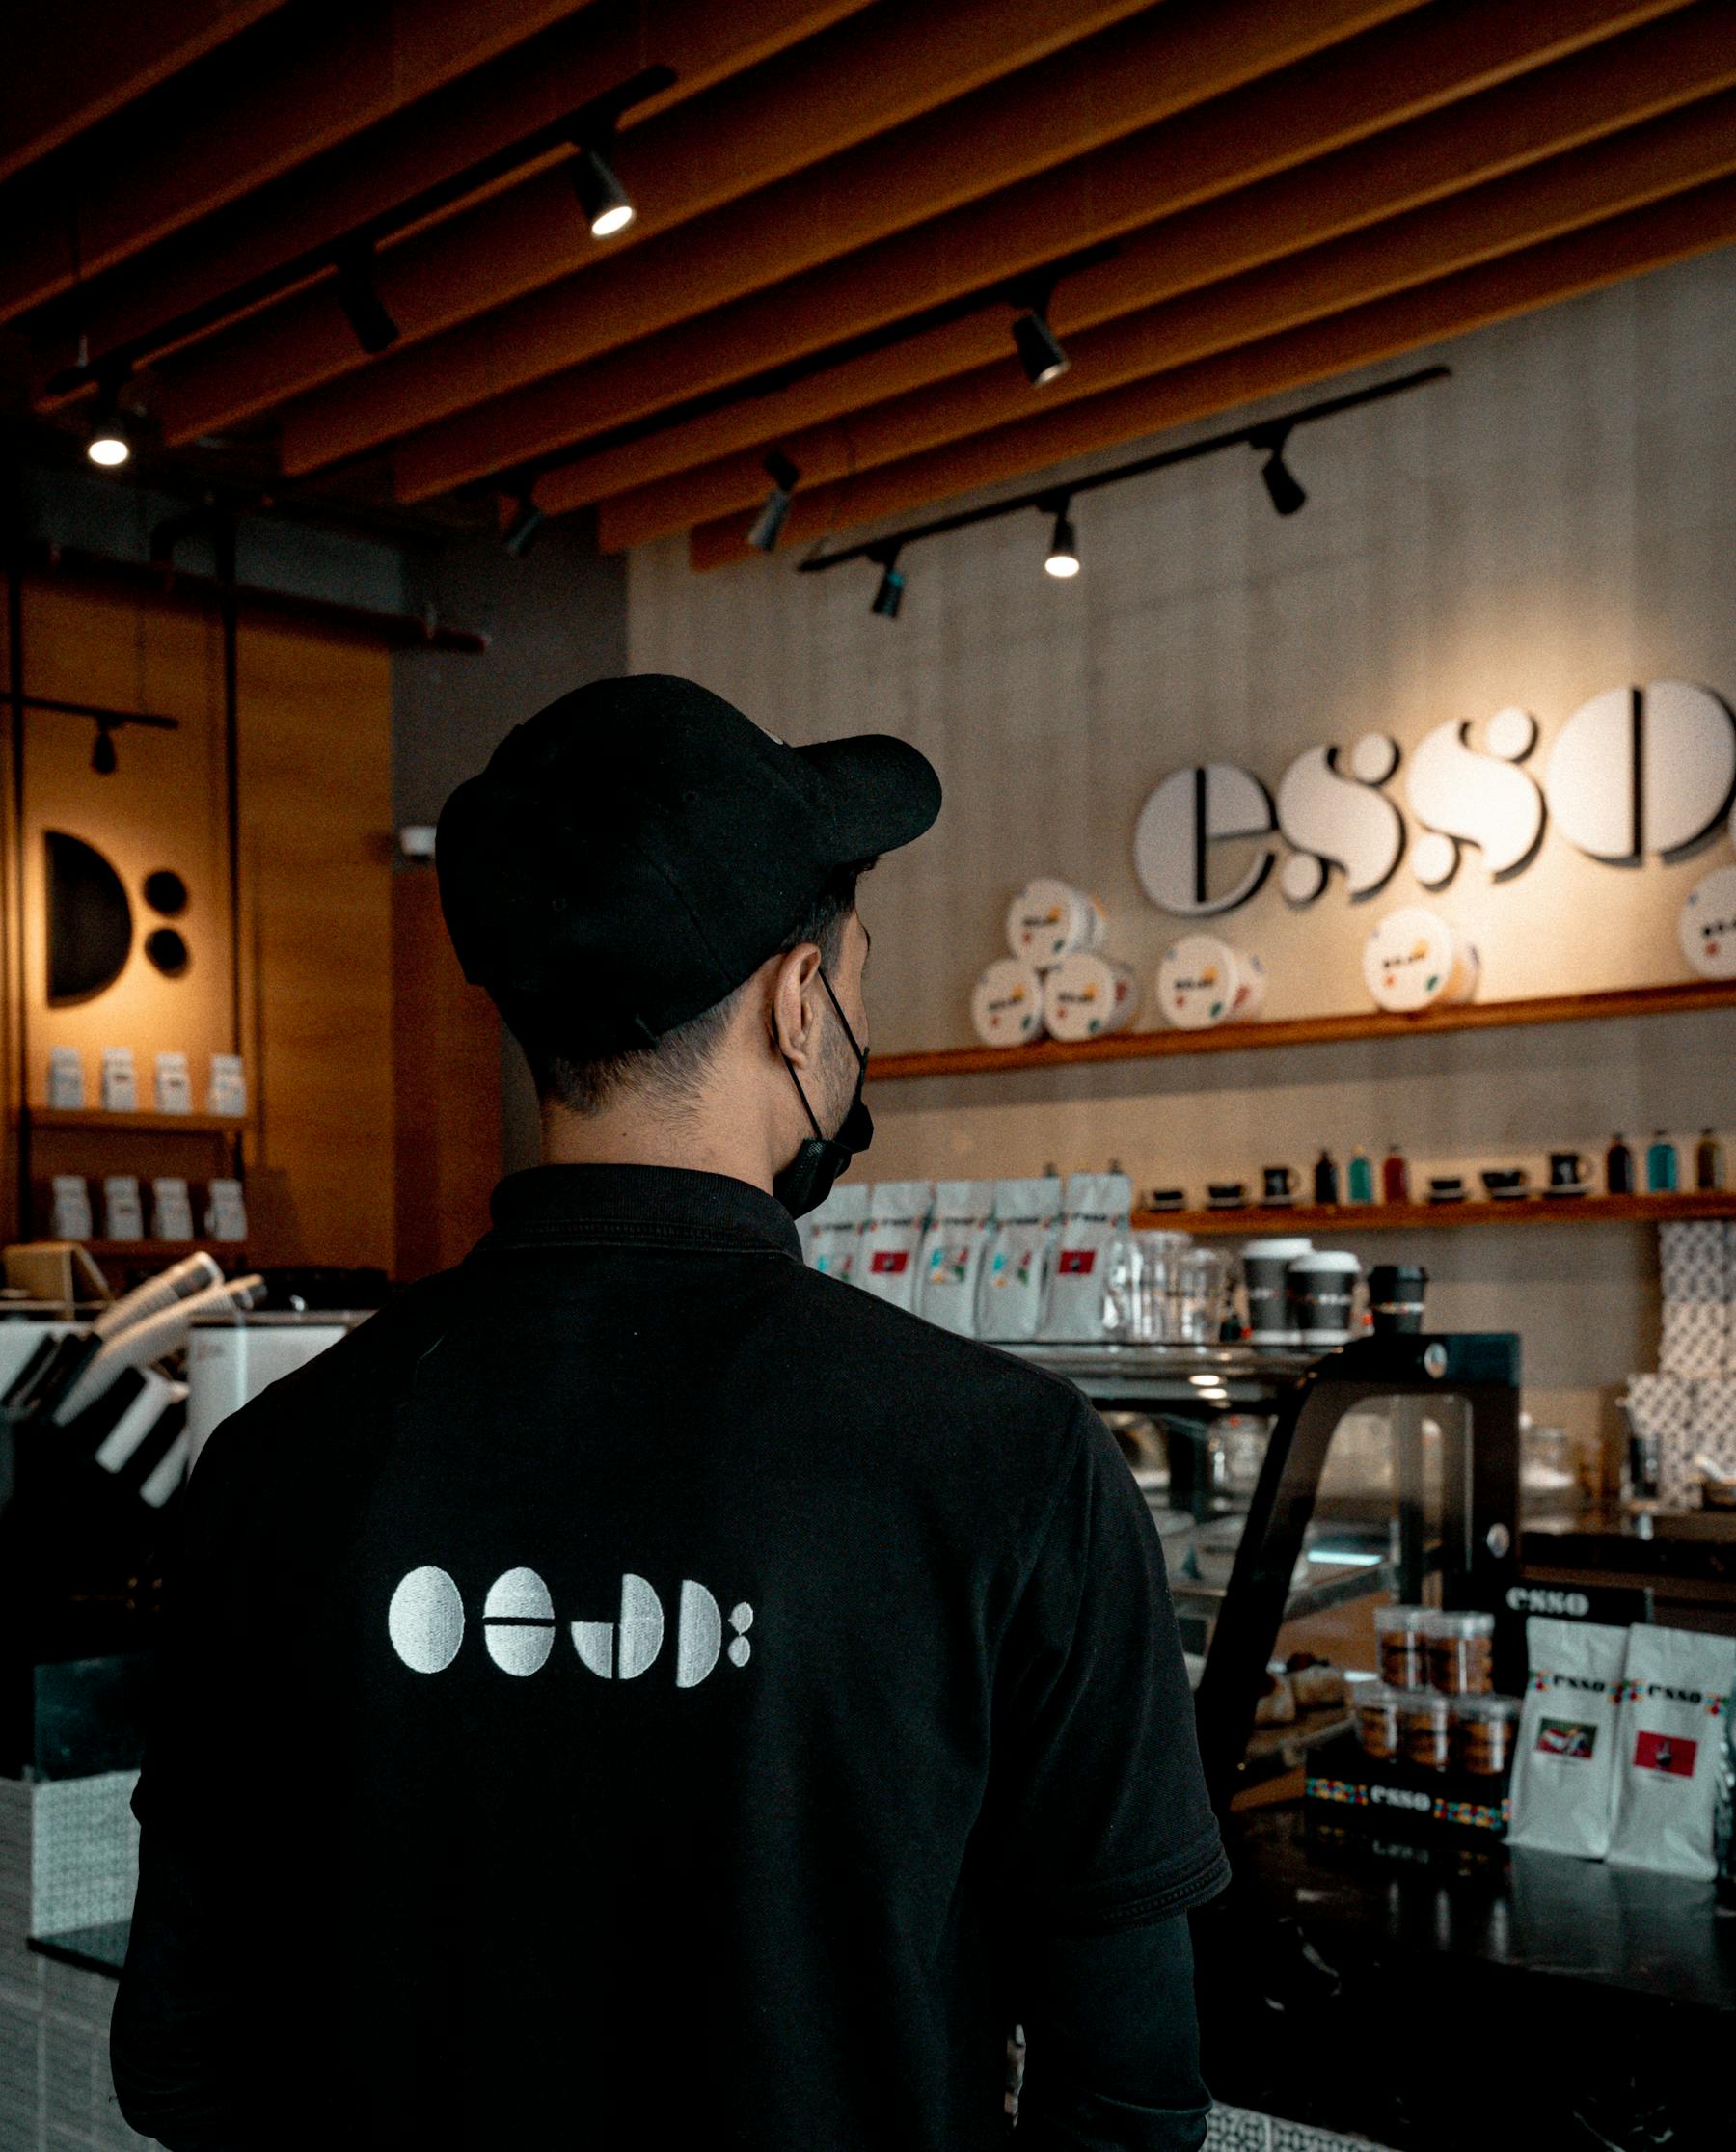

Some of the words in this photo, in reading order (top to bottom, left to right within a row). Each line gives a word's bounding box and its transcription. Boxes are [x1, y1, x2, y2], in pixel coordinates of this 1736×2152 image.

[1134, 679, 1736, 918] esso
[1505, 1587, 1589, 1617] esso
[1370, 1784, 1431, 1811] esso
